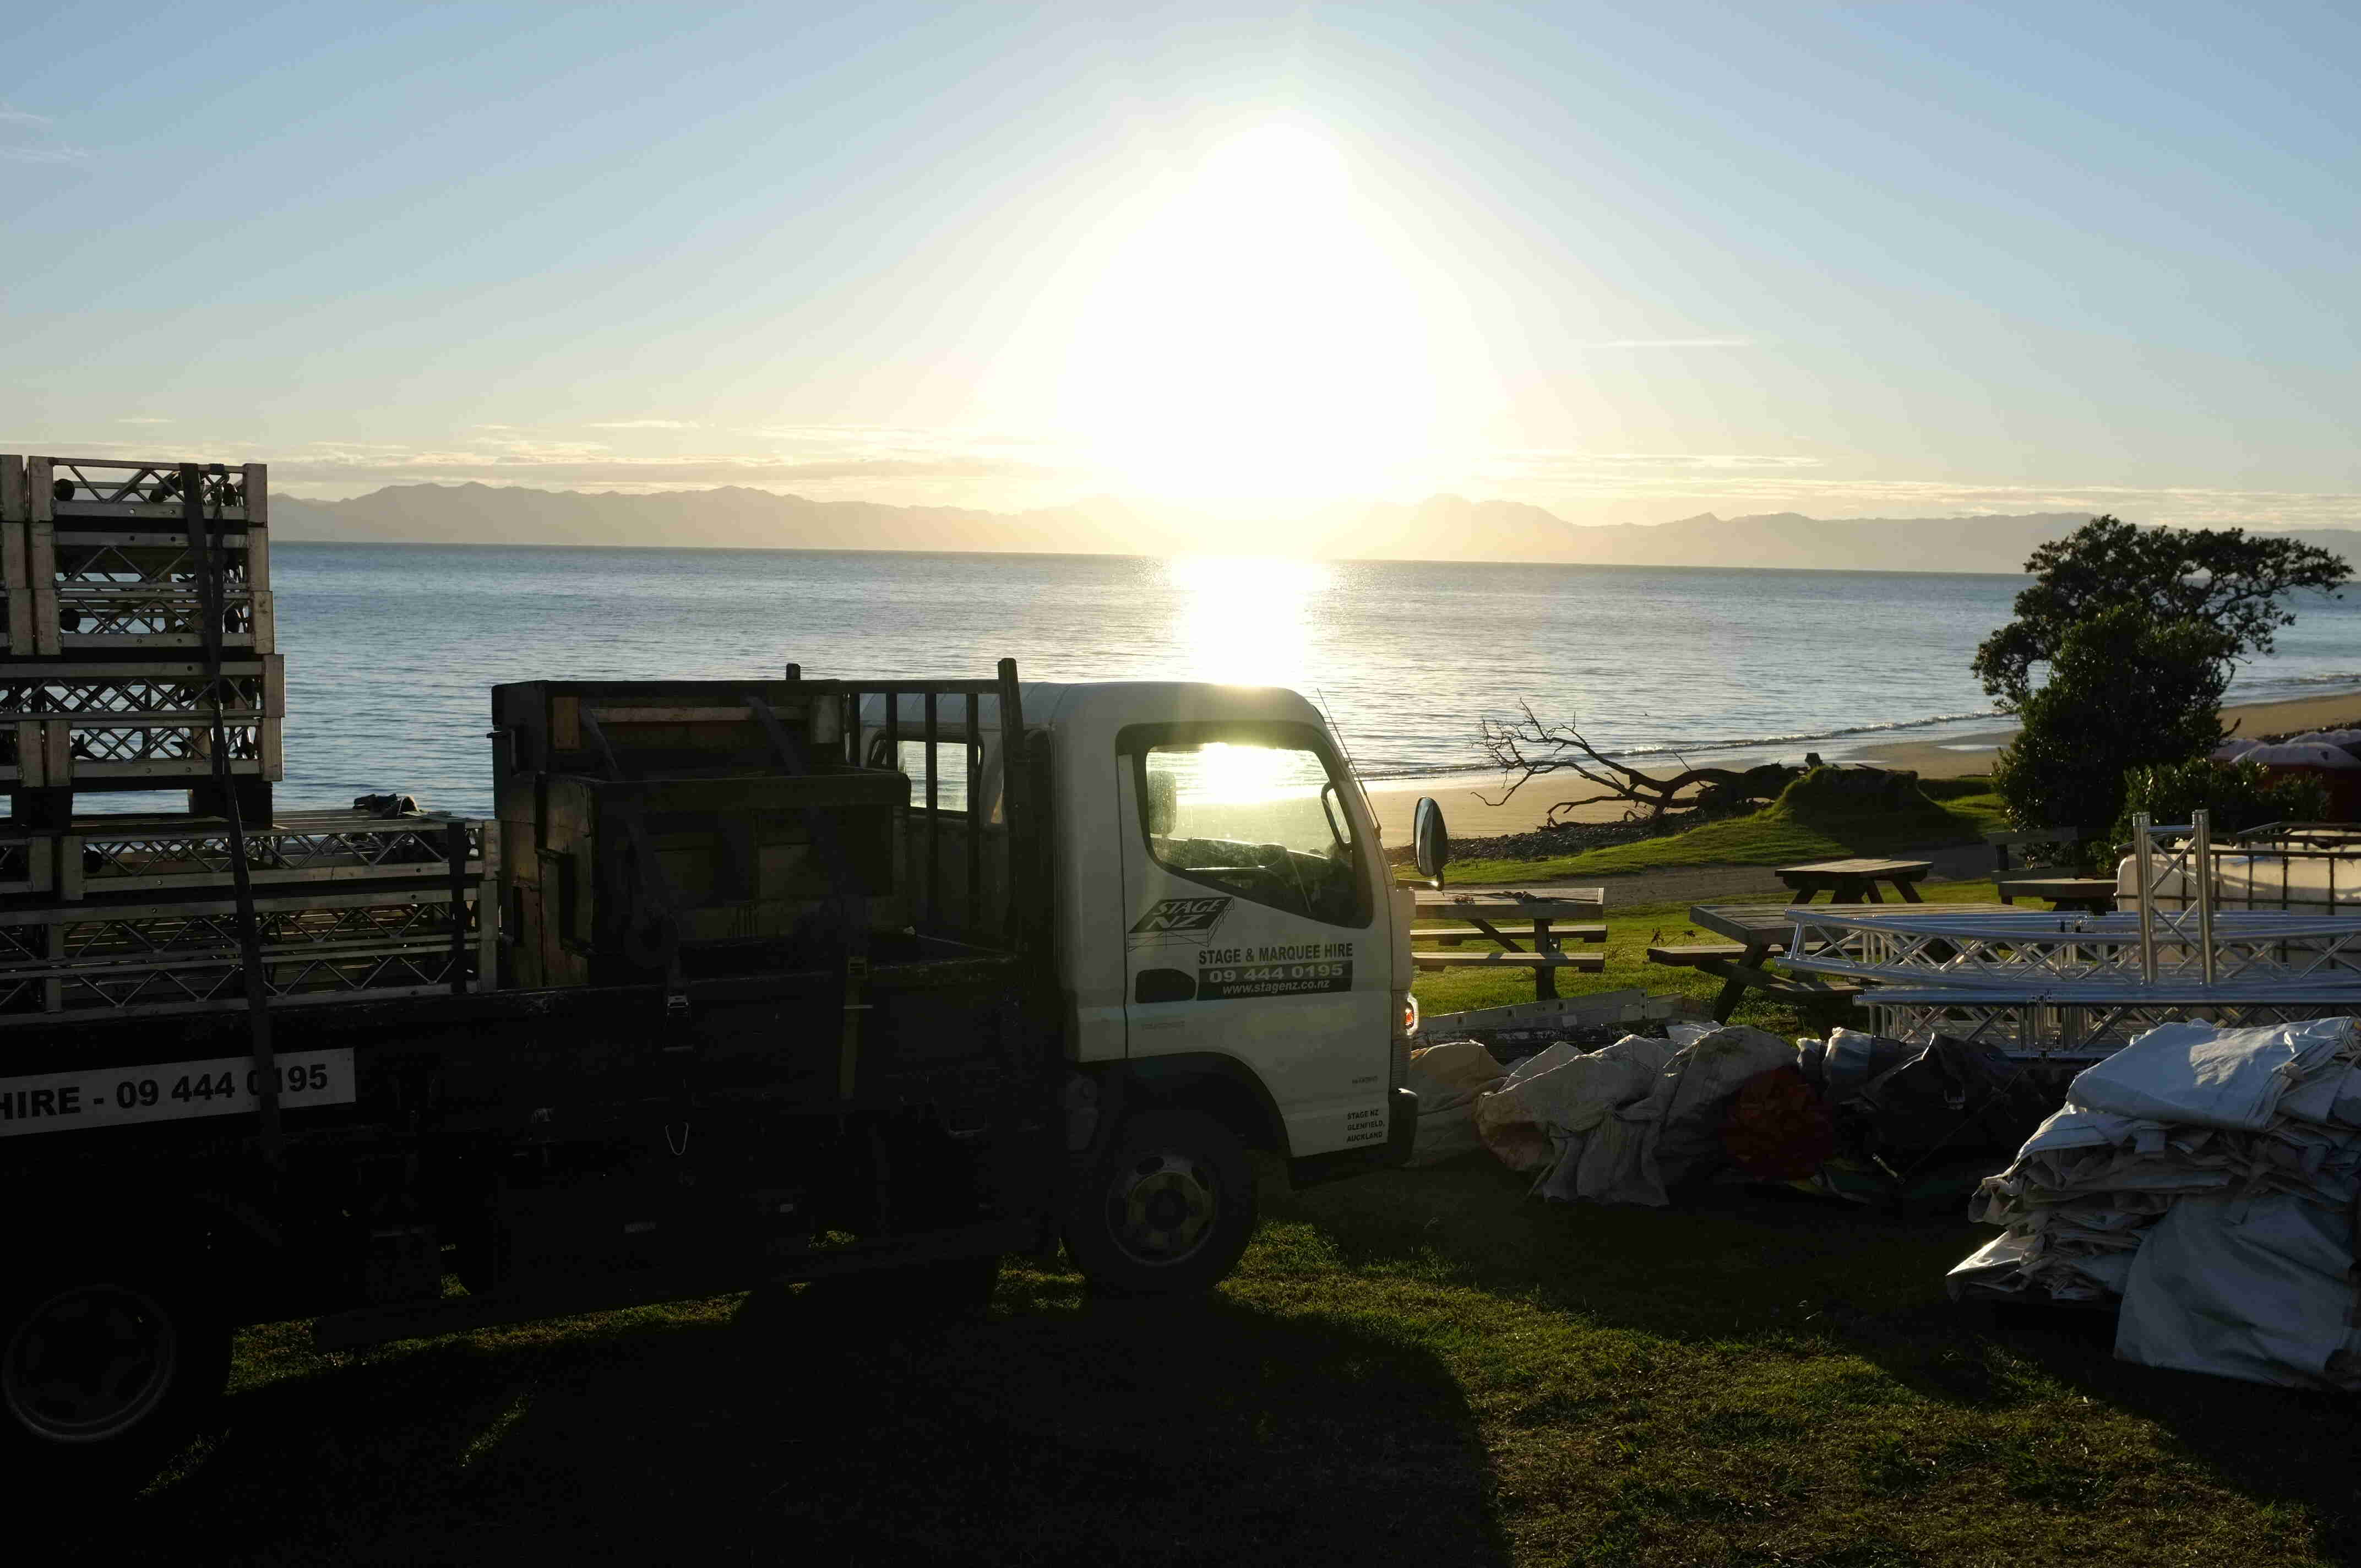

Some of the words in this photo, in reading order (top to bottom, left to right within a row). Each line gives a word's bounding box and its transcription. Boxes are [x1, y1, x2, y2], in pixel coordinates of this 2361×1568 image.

[1153, 899, 1225, 915] STAGE
[1145, 914, 1207, 929] NZ
[1199, 948, 1241, 964] STAGE
[1245, 948, 1254, 962] &
[1259, 944, 1320, 961] MARQUEE
[1325, 943, 1353, 958] HIRE
[1209, 969, 1237, 983] 09
[1243, 966, 1285, 981] 444
[1291, 964, 1343, 978] 0195
[1222, 979, 1331, 995] www.stagenz.co.nz
[116, 1079, 159, 1109] 09
[171, 1072, 235, 1102] 444
[1347, 1110, 1369, 1120] STAGE
[1370, 1109, 1379, 1117] NZ
[1347, 1131, 1383, 1142] AUCKLAND
